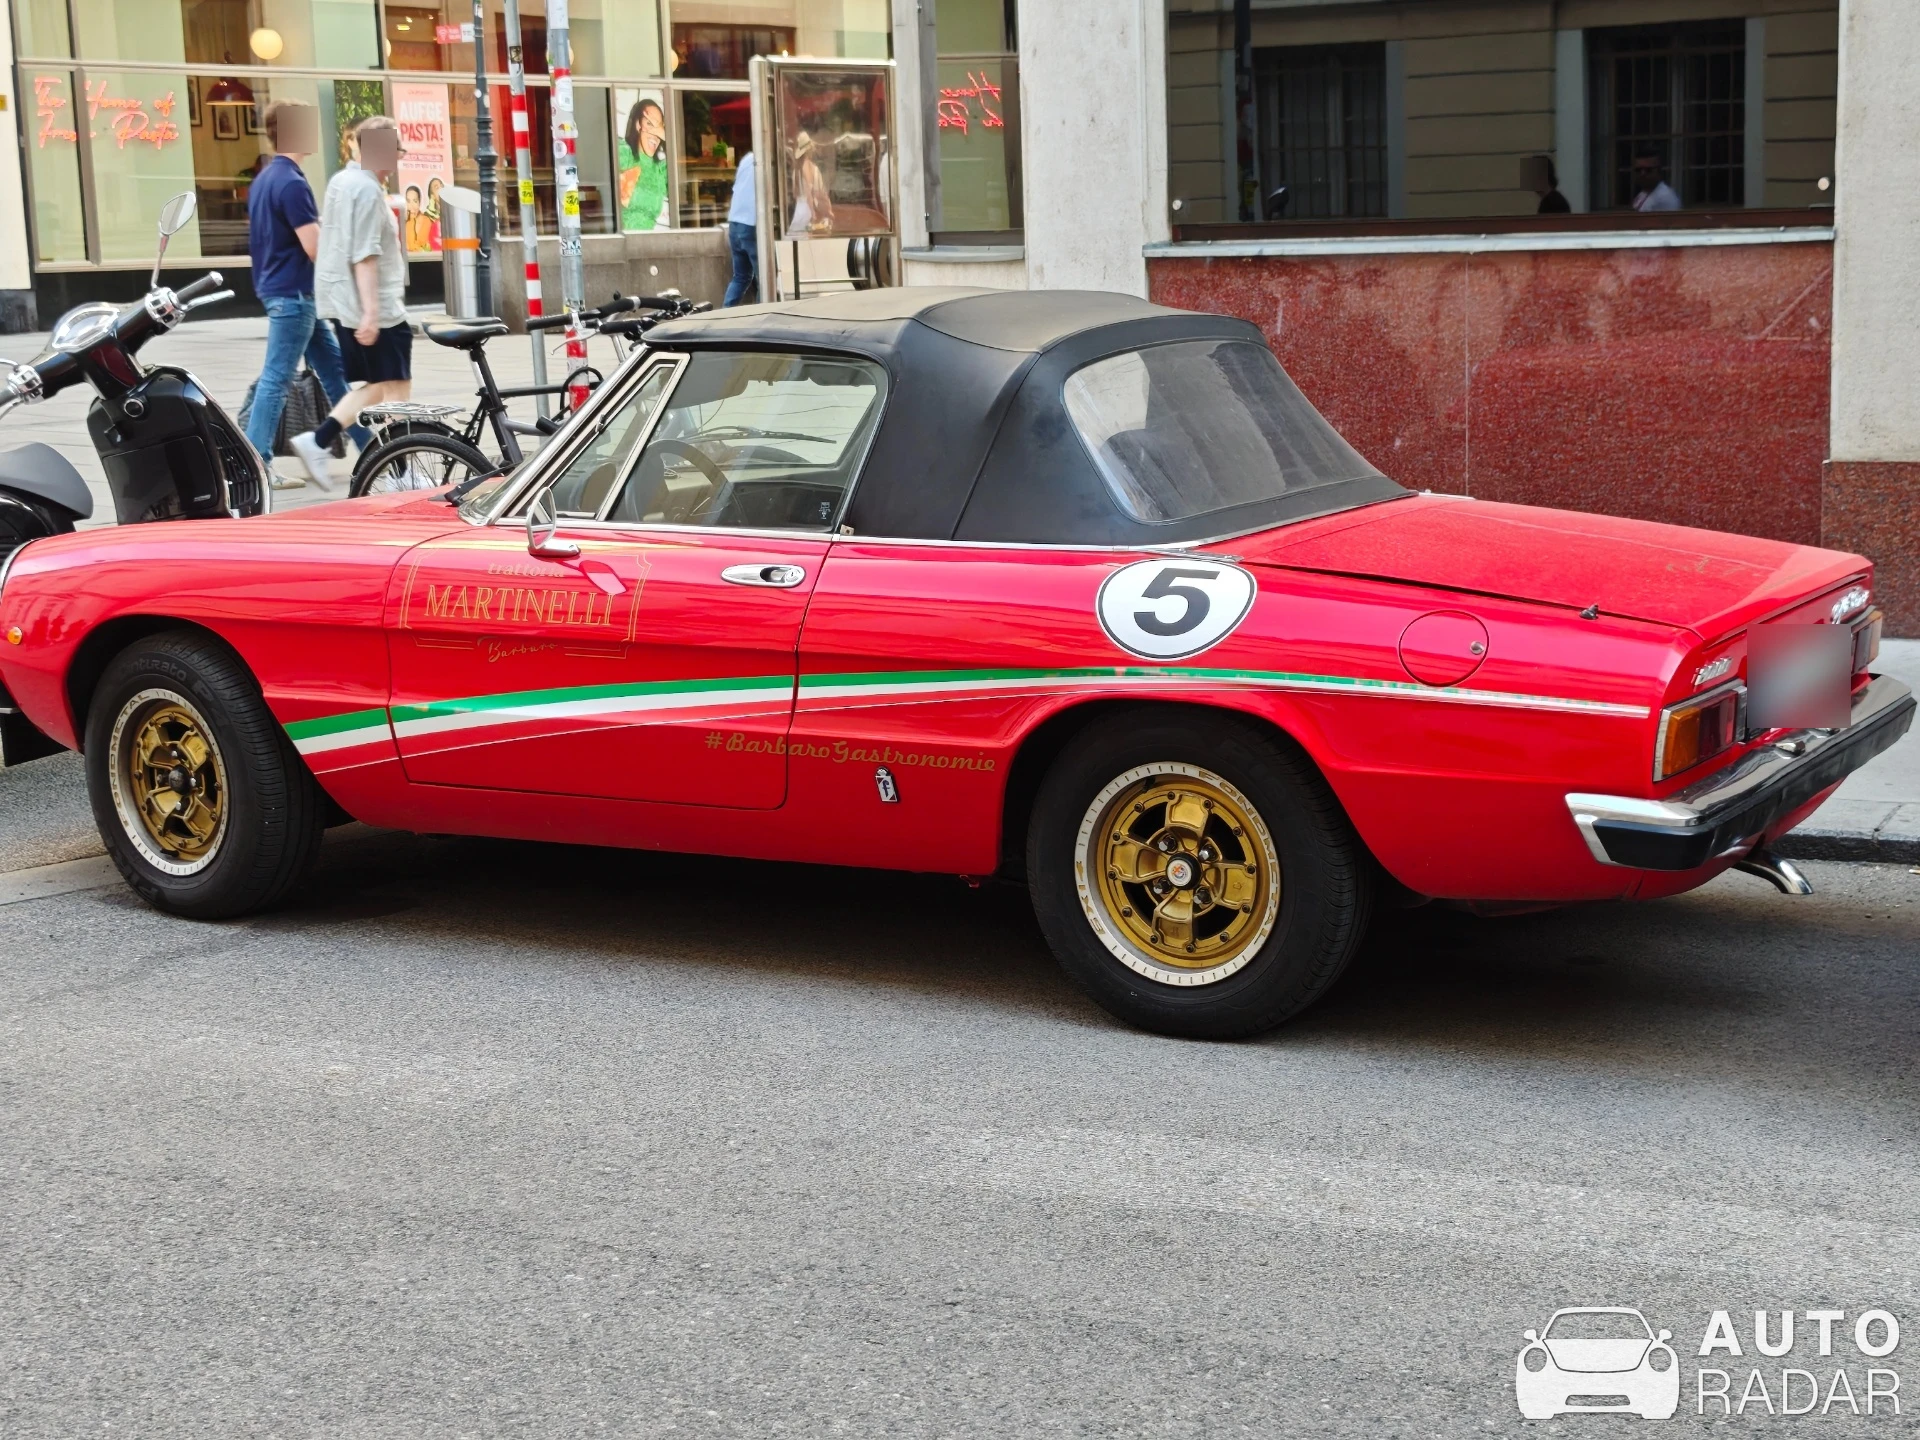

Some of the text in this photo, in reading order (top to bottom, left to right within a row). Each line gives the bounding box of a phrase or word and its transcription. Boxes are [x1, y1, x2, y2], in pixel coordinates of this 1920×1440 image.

[111, 110, 179, 150] Pasta
[400, 122, 443, 142] PASTA!
[488, 562, 565, 578] trattoria
[424, 584, 617, 626] MARTINELLI
[1132, 567, 1222, 637] 5
[477, 636, 558, 663] Barbaro
[704, 731, 995, 772] #BarbaroGastronomie
[1198, 770, 1280, 945] FONDMETAL
